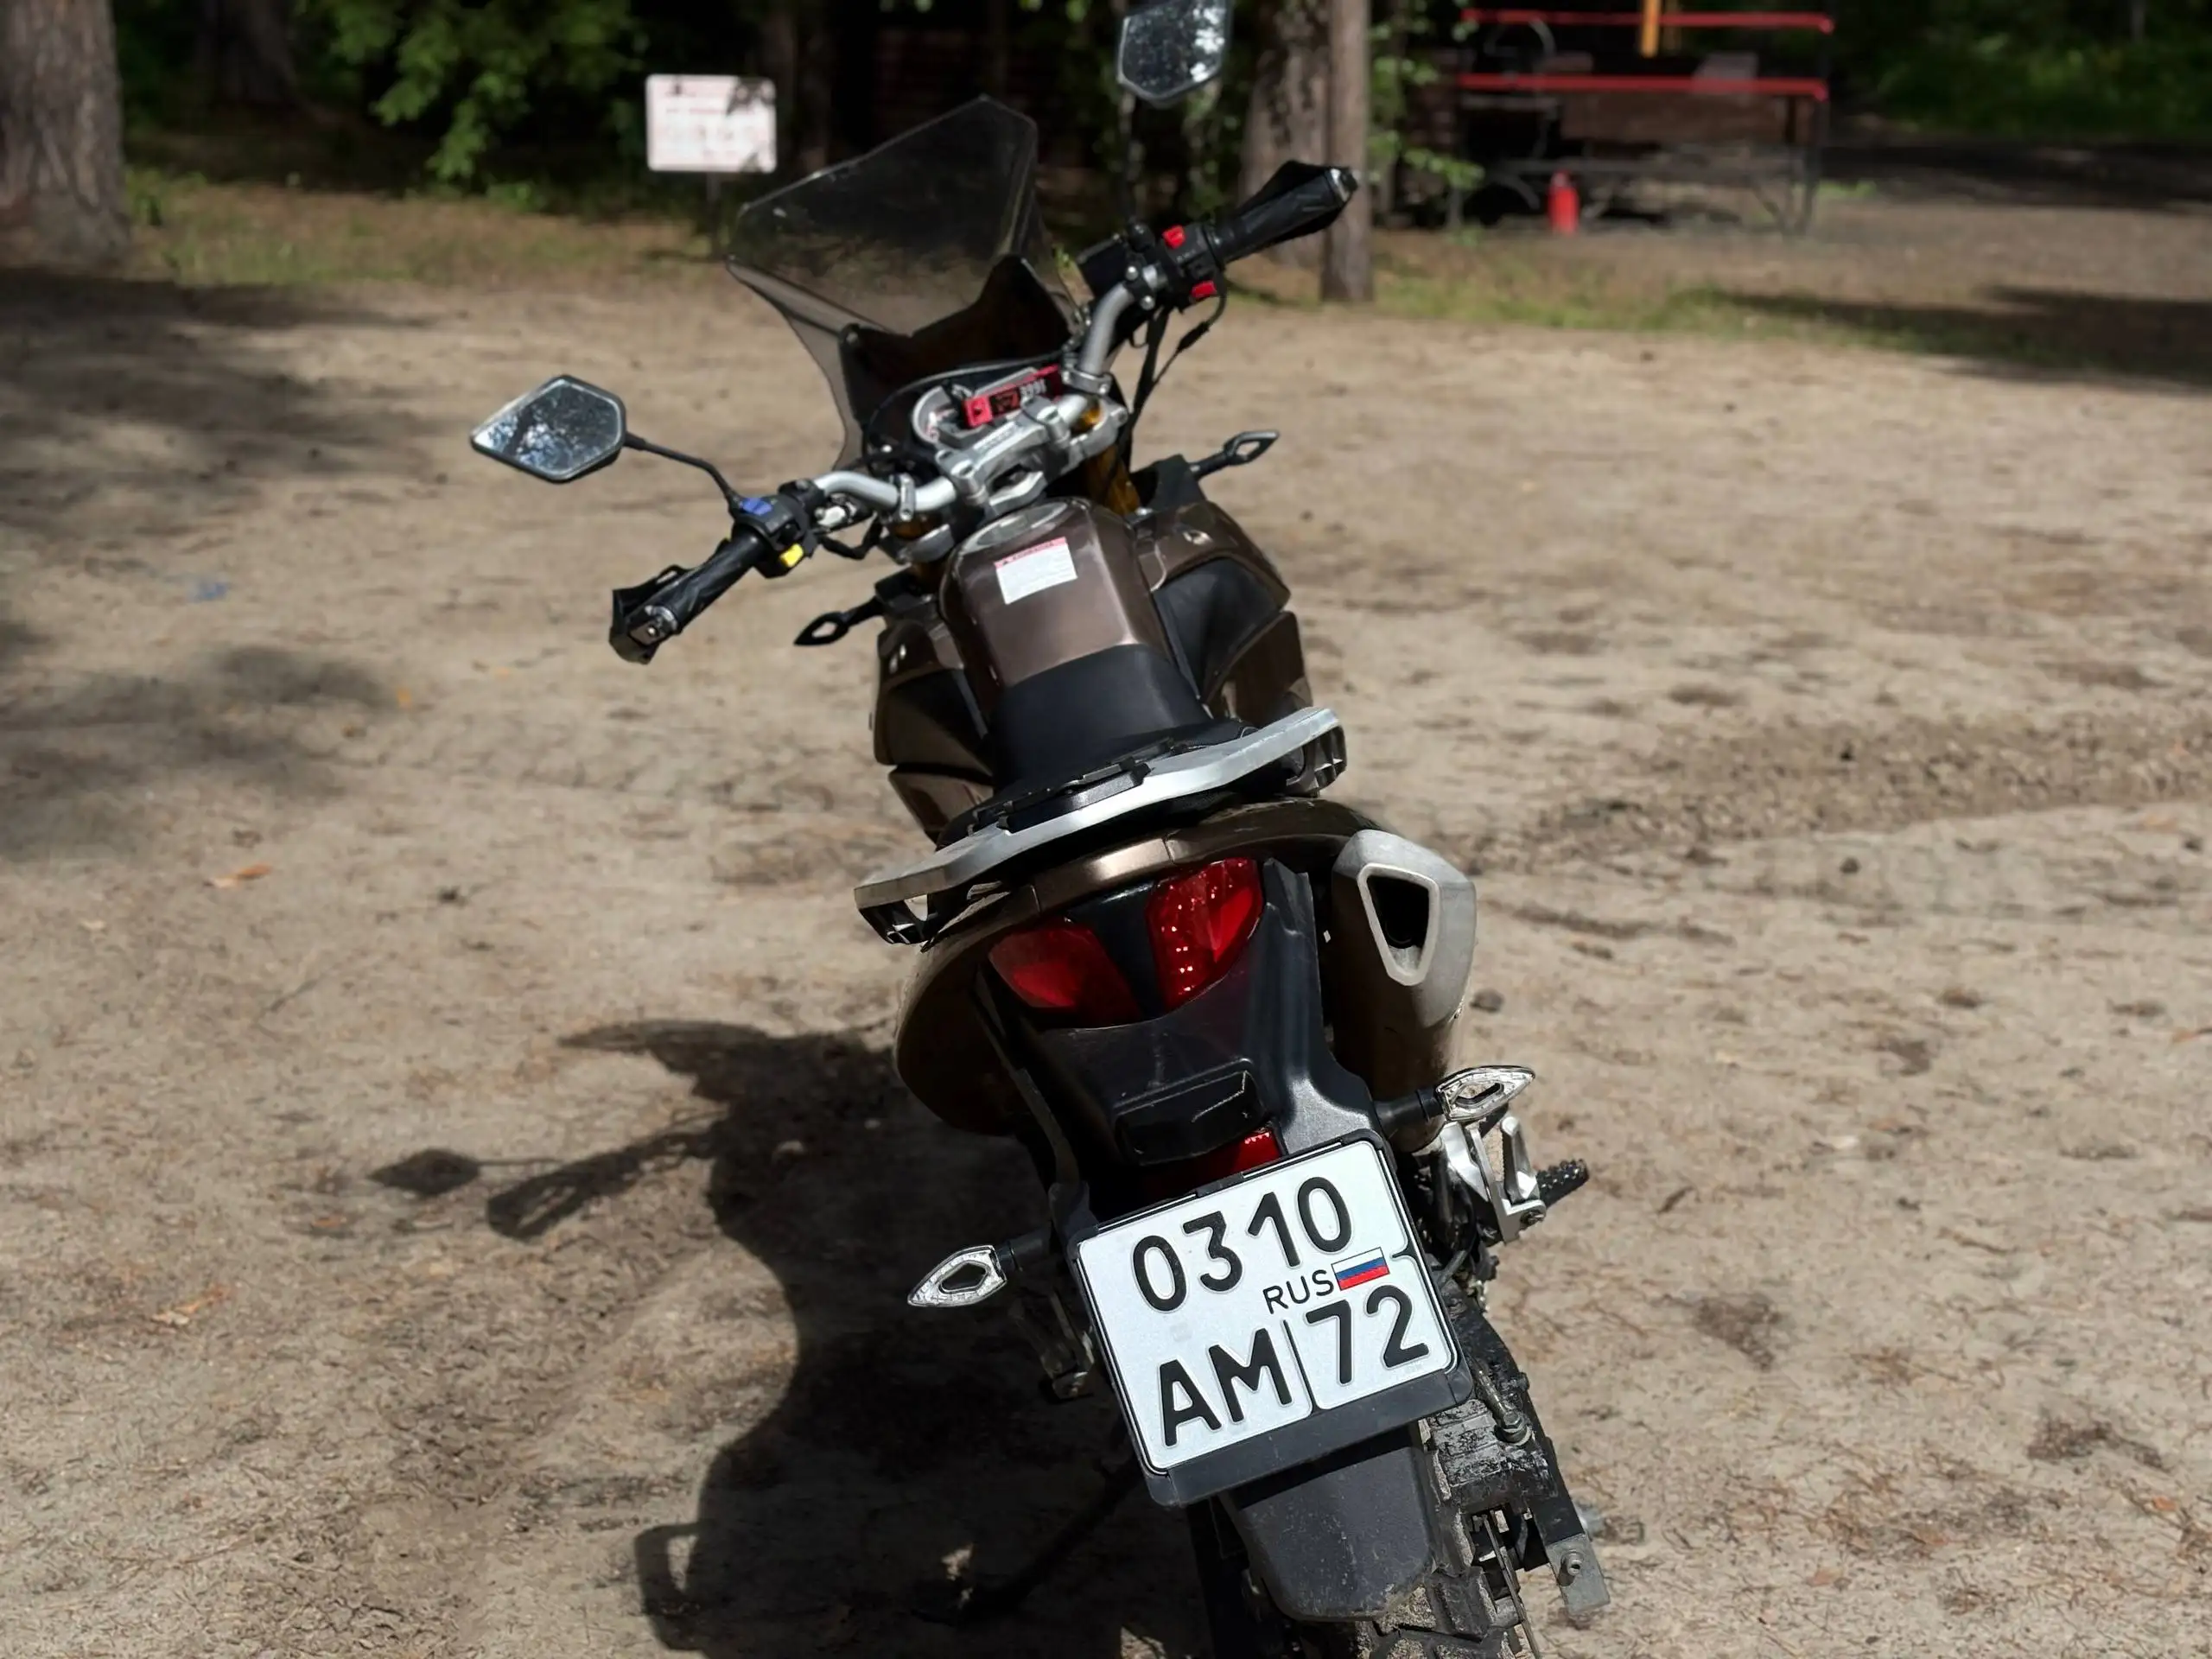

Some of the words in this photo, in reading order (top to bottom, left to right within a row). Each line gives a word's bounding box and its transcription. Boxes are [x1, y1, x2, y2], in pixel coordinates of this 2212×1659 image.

[1132, 1176, 1352, 1312] 0310
[1262, 1269, 1334, 1315] RUS
[1159, 1327, 1293, 1447] AM
[1305, 1285, 1430, 1385] 72
